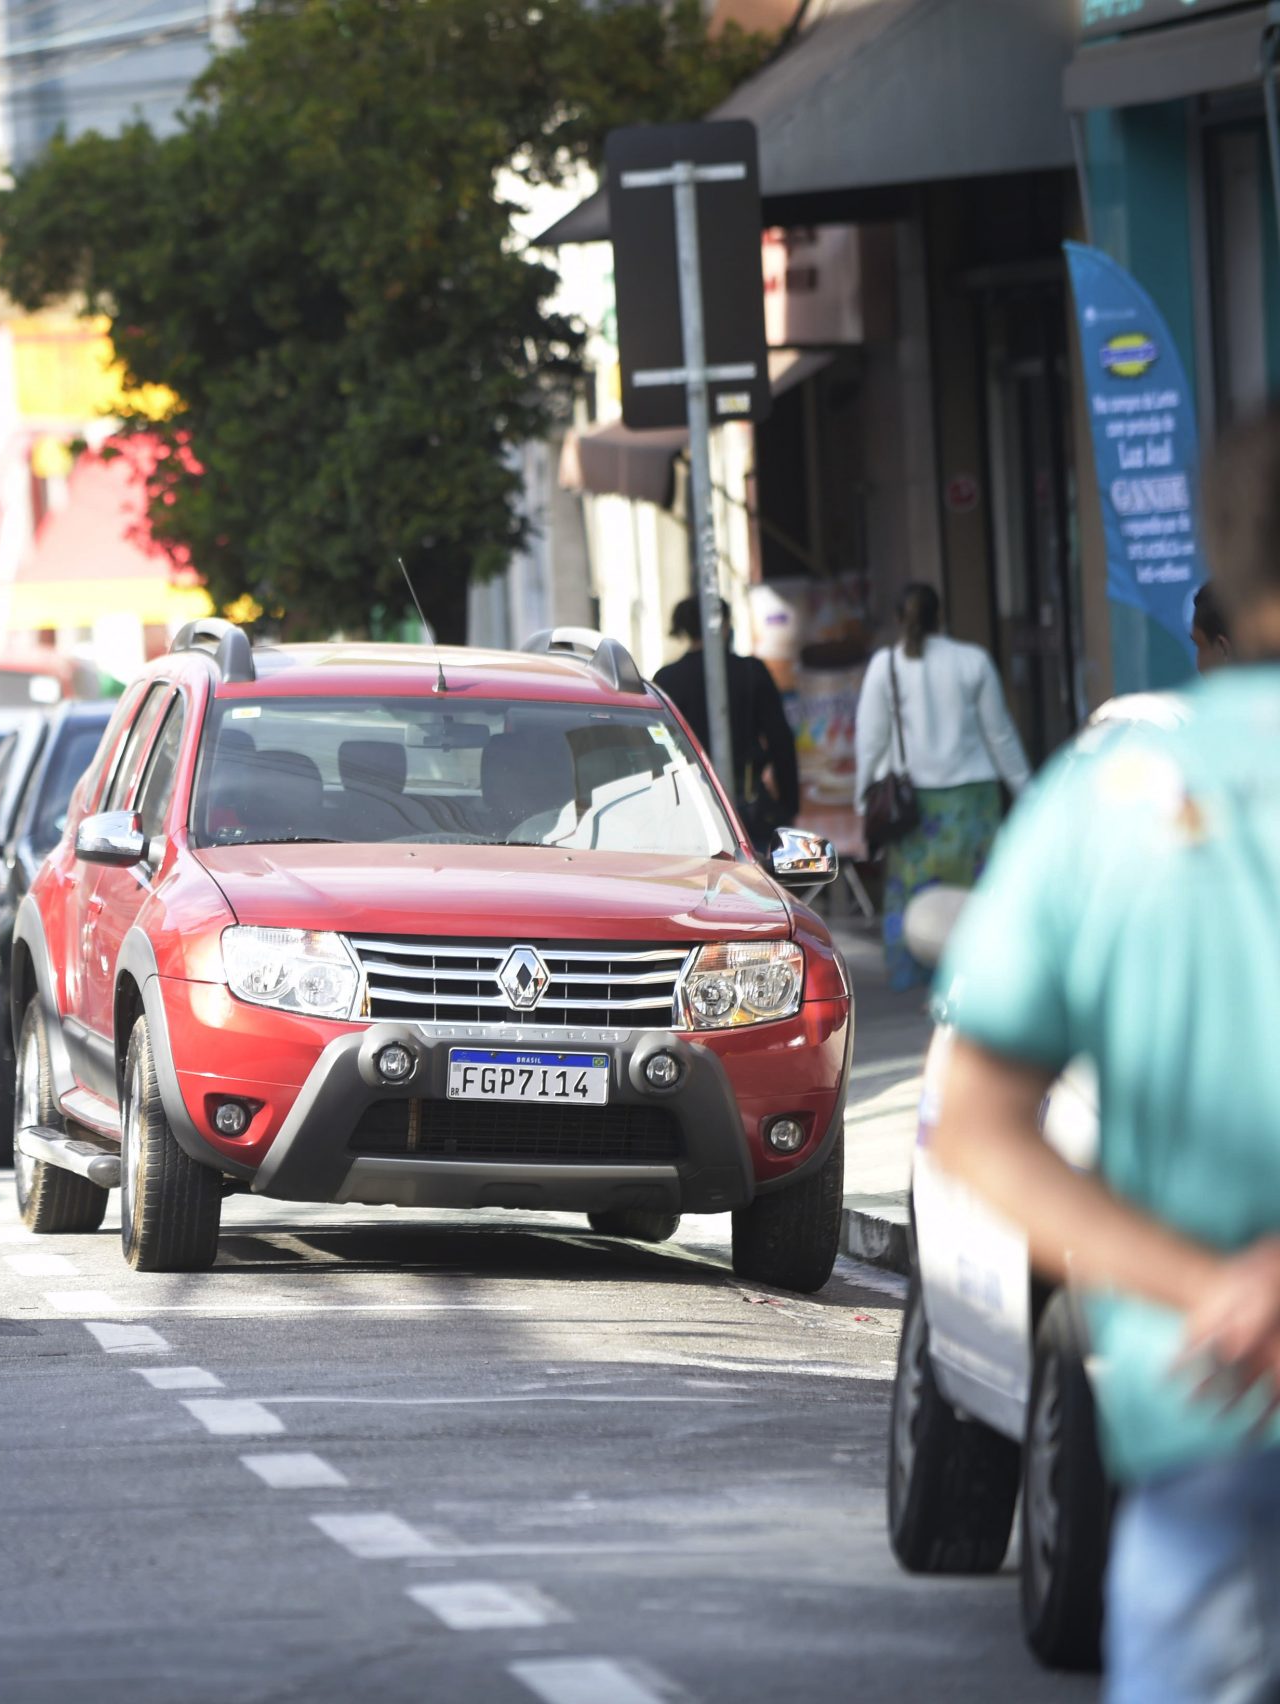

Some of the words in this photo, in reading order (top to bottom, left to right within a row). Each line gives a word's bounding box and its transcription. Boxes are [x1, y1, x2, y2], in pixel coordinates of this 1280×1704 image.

[516, 1056, 542, 1065] BRASIL
[462, 1066, 589, 1098] FGP7I14
[450, 1087, 460, 1096] BR
